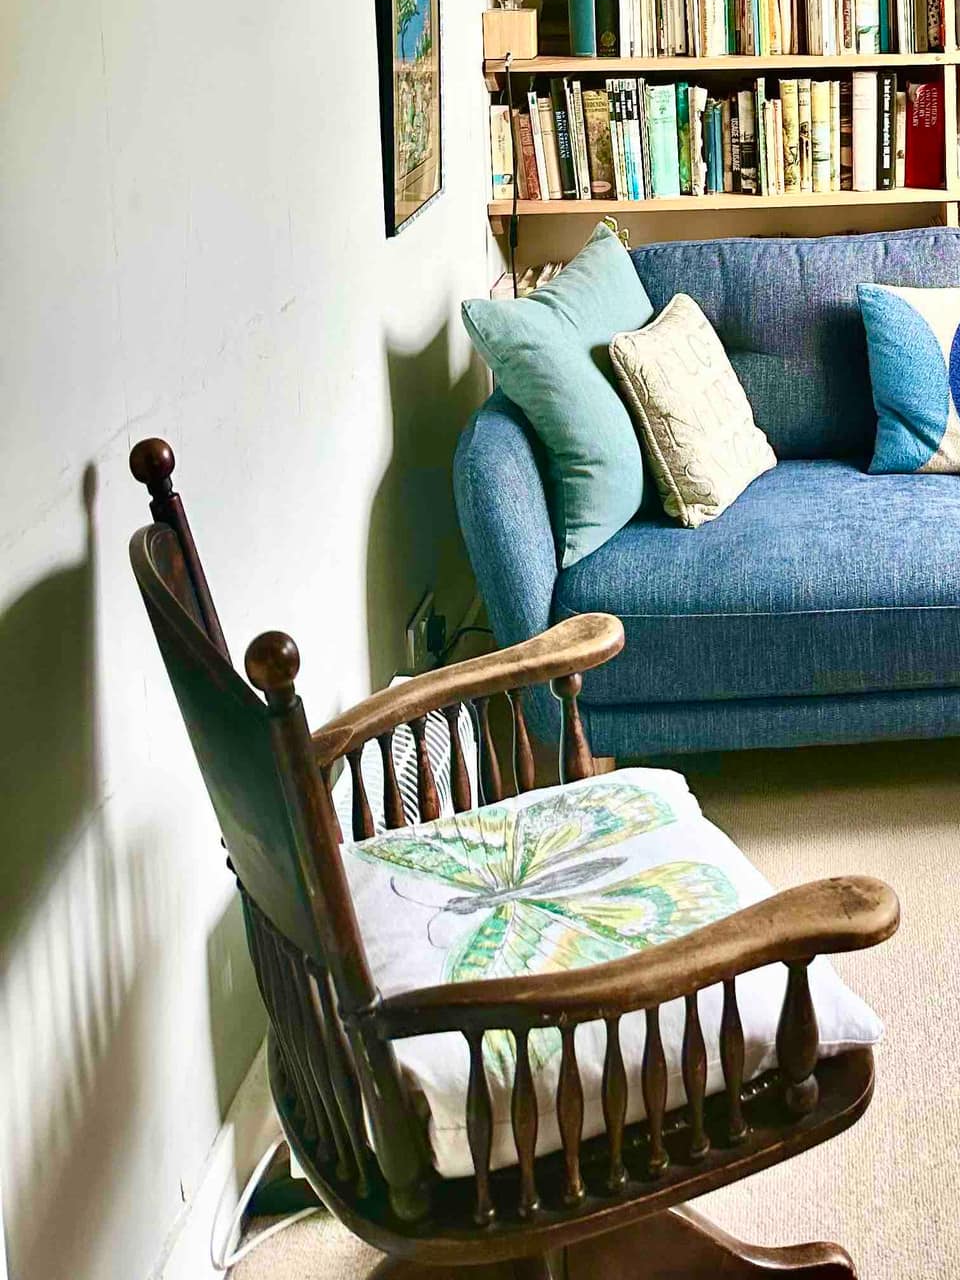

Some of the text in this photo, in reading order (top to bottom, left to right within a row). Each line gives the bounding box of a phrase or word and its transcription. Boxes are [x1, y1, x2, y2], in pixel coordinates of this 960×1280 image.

[555, 111, 566, 159] BRIAN KEENAN
[731, 118, 739, 137] USAGE
[732, 144, 740, 171] ABUSAGE
